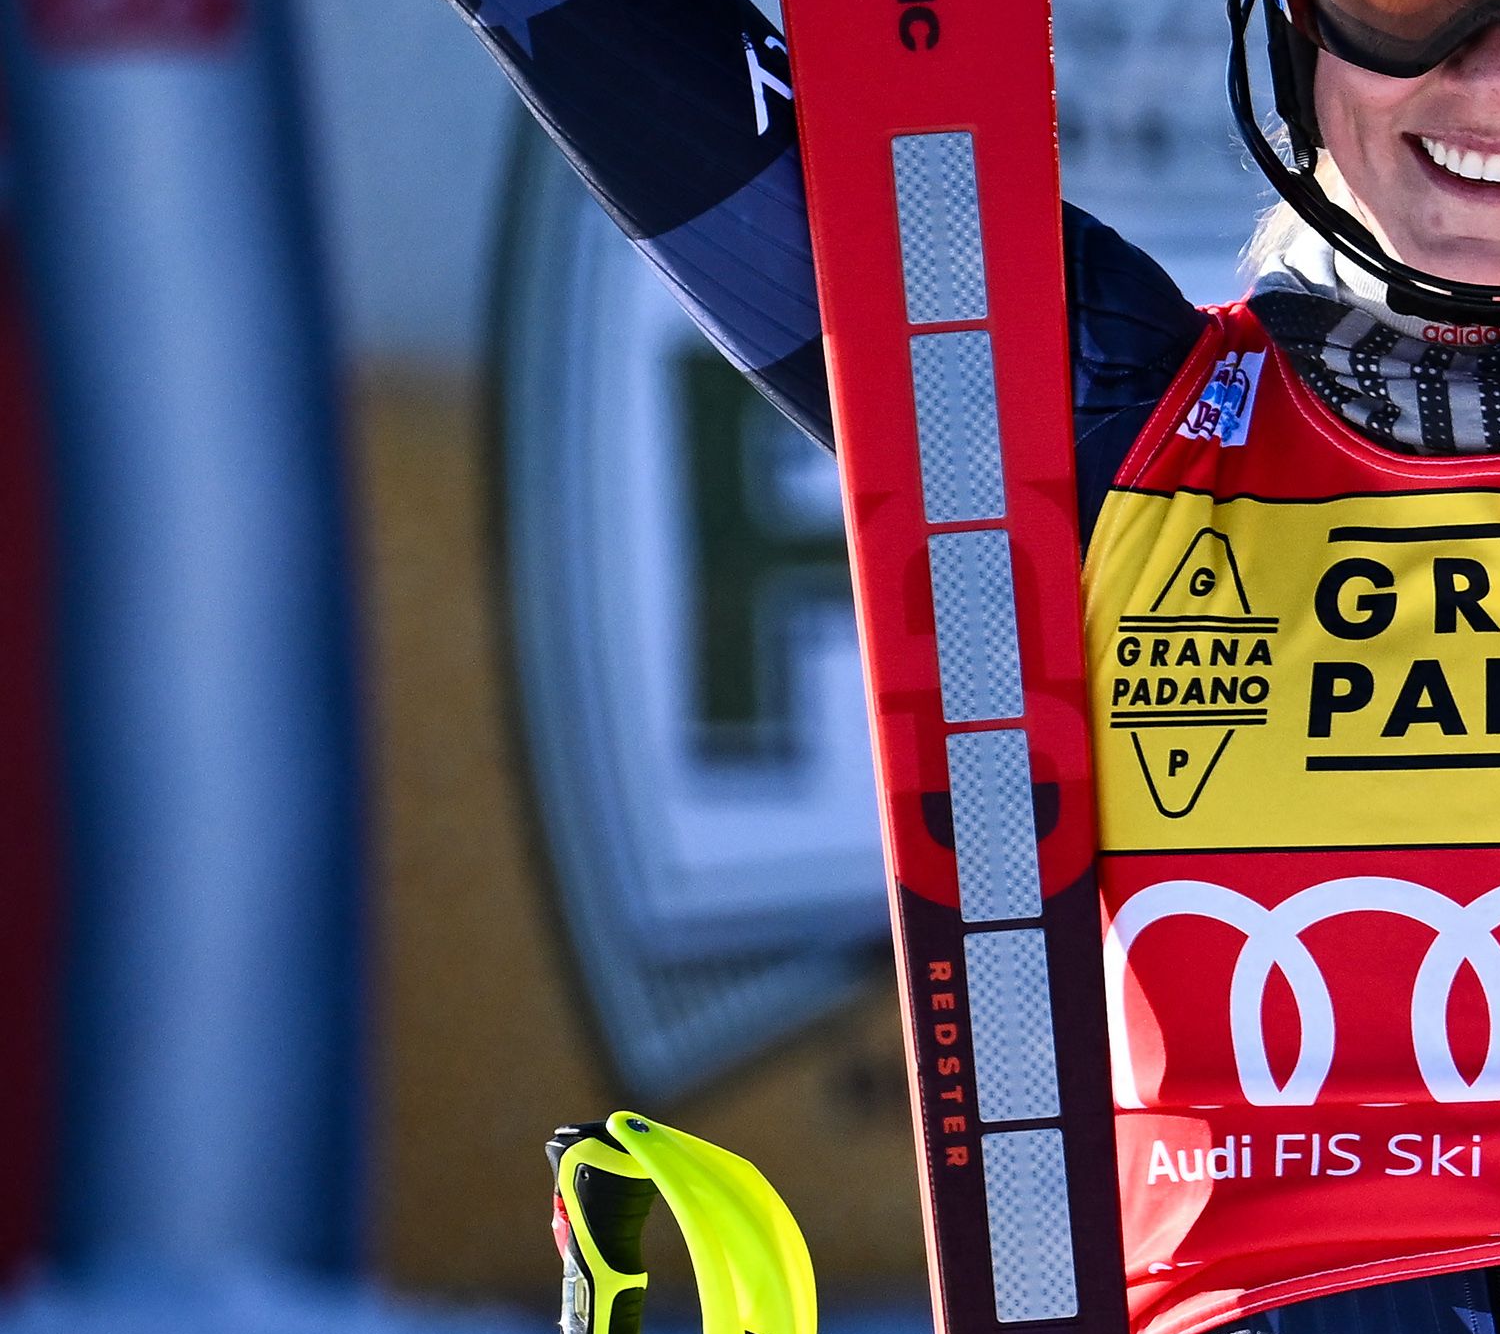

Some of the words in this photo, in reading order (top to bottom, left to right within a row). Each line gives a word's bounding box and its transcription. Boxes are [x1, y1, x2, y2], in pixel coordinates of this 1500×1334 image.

[1188, 567, 1215, 597] G
[1116, 635, 1273, 667] GRANA
[1112, 675, 1270, 707] PADANO
[1167, 748, 1190, 777] P
[925, 959, 970, 1169] REDSTER
[1147, 1137, 1253, 1185] Audi
[1275, 1133, 1363, 1179] FIS
[1384, 1132, 1481, 1180] Ski
